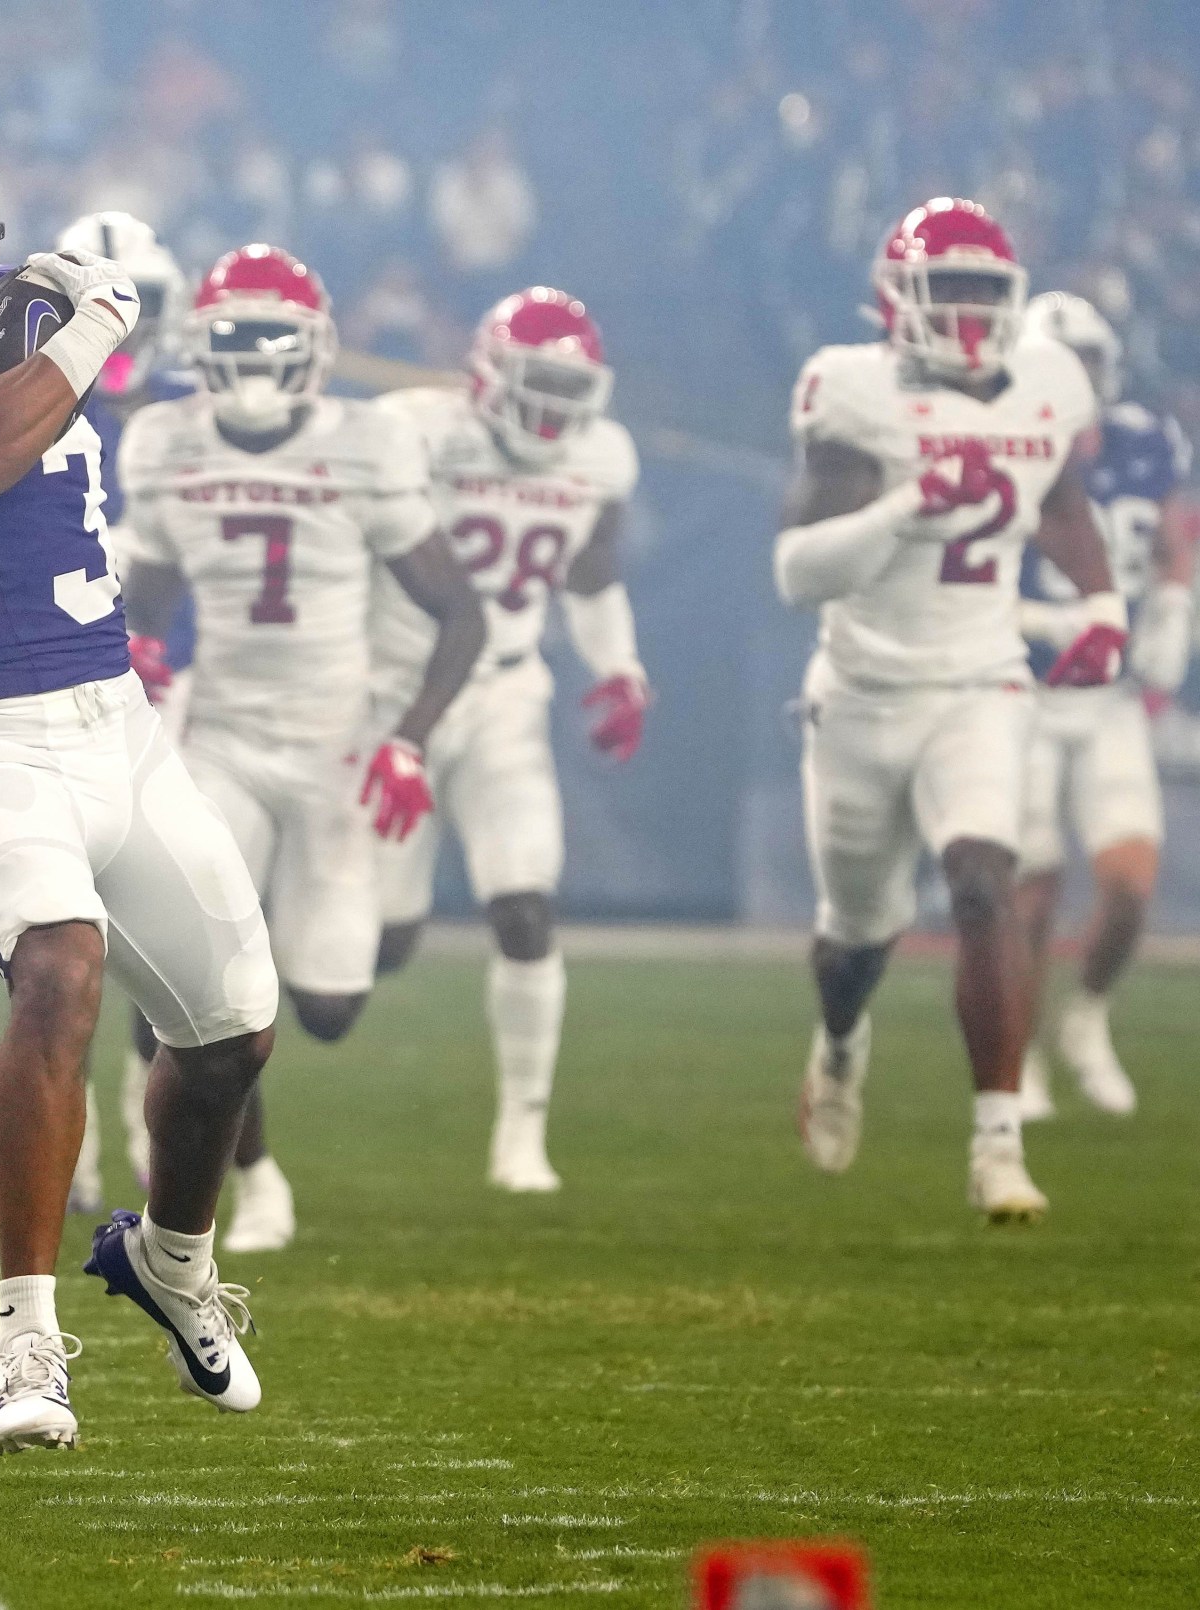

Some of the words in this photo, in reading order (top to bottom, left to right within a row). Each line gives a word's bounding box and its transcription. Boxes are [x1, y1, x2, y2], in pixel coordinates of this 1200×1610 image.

[41, 413, 122, 625] 3
[220, 515, 296, 624] 7
[452, 515, 569, 612] 28
[939, 467, 1015, 583] 2
